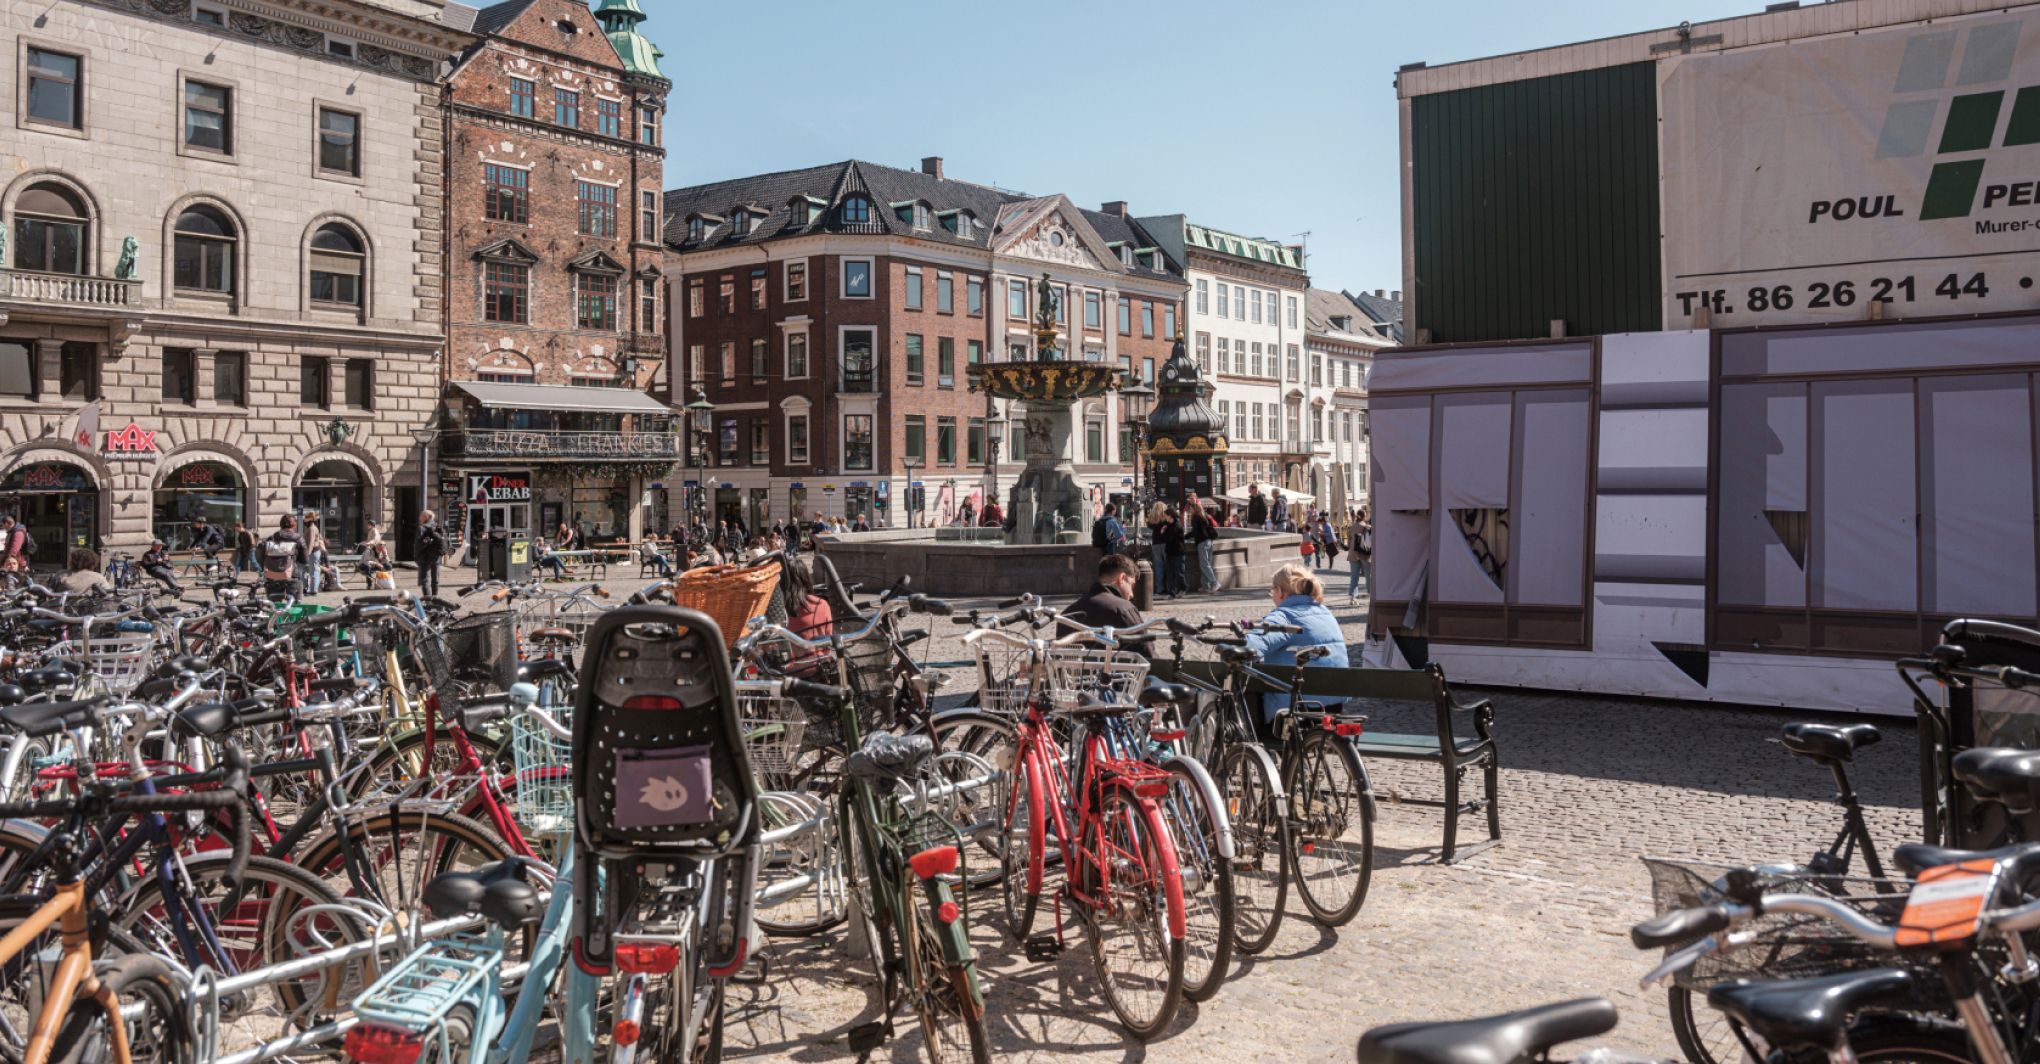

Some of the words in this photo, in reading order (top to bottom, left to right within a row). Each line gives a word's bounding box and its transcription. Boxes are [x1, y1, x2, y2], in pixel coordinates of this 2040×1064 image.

[64, 12, 158, 58] BANK
[1809, 195, 1904, 223] POUL
[1675, 290, 1733, 316] Tlf.
[1747, 285, 1794, 312] 86
[1807, 280, 1857, 308] 26
[1870, 276, 1916, 303] 21
[1935, 272, 1989, 300] 44
[108, 423, 157, 451] MAX
[494, 431, 551, 450] PIZZA
[24, 464, 64, 486] MAX
[183, 464, 214, 484] MAX
[469, 476, 530, 500] KEBAB
